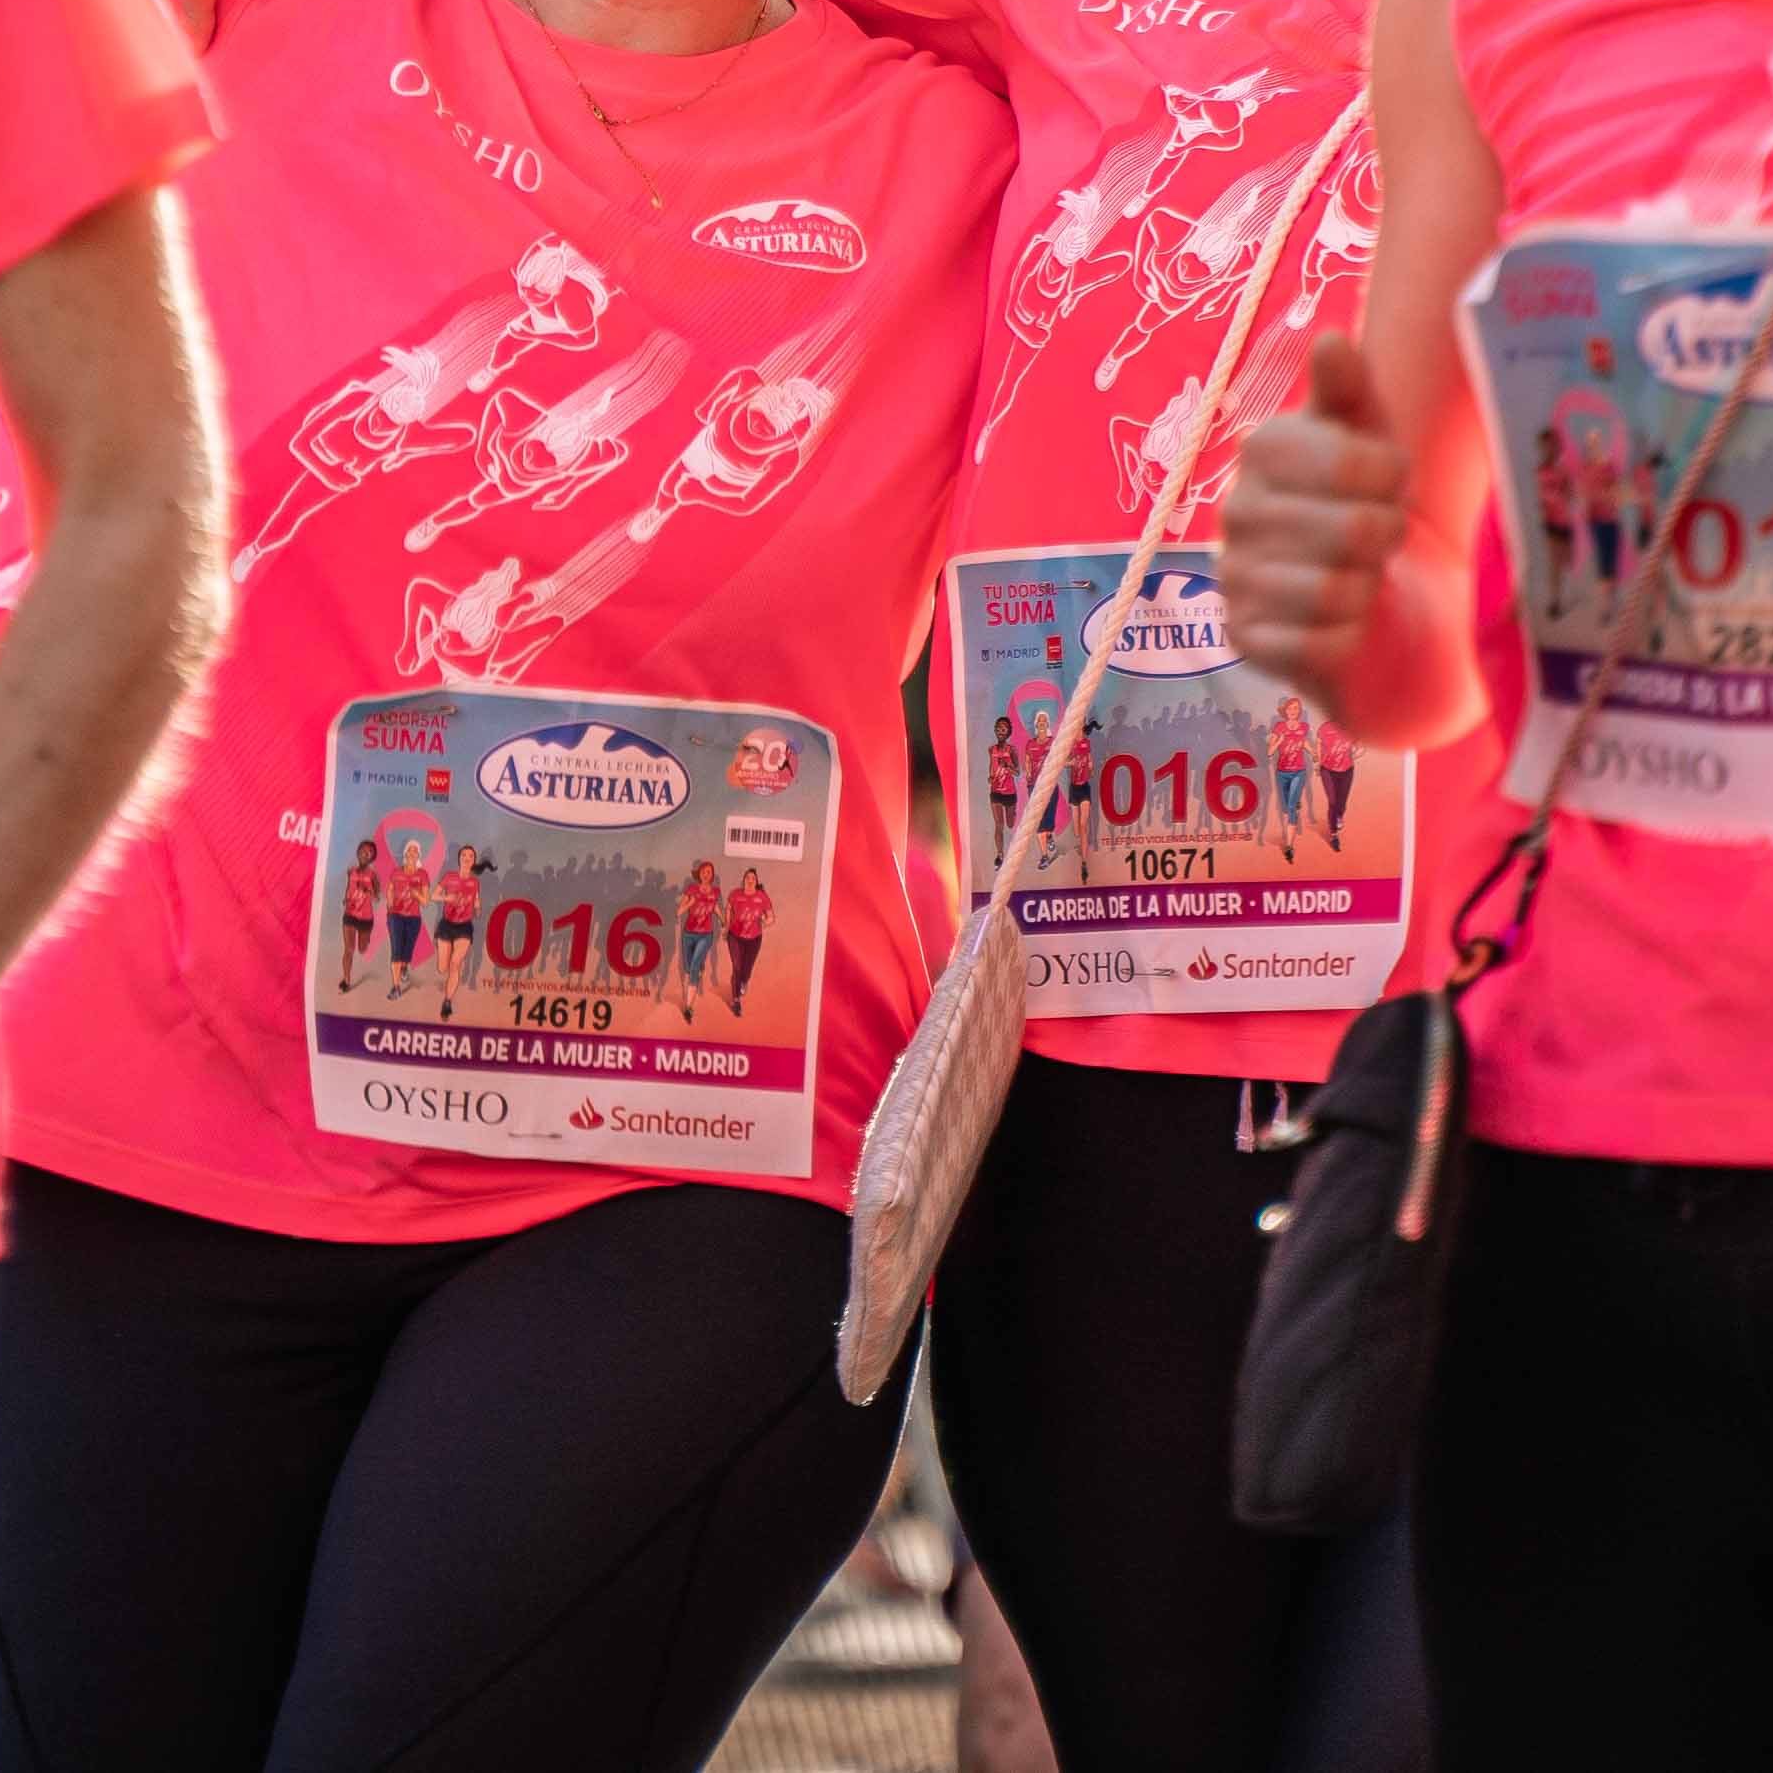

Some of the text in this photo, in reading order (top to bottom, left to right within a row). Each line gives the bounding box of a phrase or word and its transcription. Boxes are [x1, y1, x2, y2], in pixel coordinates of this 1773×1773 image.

[389, 59, 543, 194] OYSHO
[708, 227, 853, 264] ASTURIANA
[982, 584, 1002, 599] TU
[986, 599, 1055, 627] SUMA
[996, 648, 1040, 659] MADRID
[1113, 622, 1226, 653] STURIA
[362, 725, 445, 755] SUMA
[368, 770, 418, 787] MADRID
[493, 754, 675, 807] ASTURIANA
[530, 754, 671, 775] CENTRAL LECHERA
[1099, 749, 1259, 826] 016
[1124, 847, 1215, 881] 10671
[1022, 897, 1107, 923] CARRERA
[1109, 895, 1131, 919] DE
[1136, 894, 1161, 918] LA
[1166, 892, 1243, 917] MUJER
[1262, 889, 1352, 915] MADRID
[486, 897, 664, 977] 016
[1223, 951, 1356, 980] Santander
[509, 993, 613, 1031] 14619
[363, 1027, 473, 1059] CARRERA
[480, 1036, 511, 1062] DE
[516, 1038, 545, 1064] LA
[553, 1041, 633, 1071] MUJER
[655, 1047, 750, 1077] MADRID
[363, 1079, 756, 1141] OYSHO Santander
